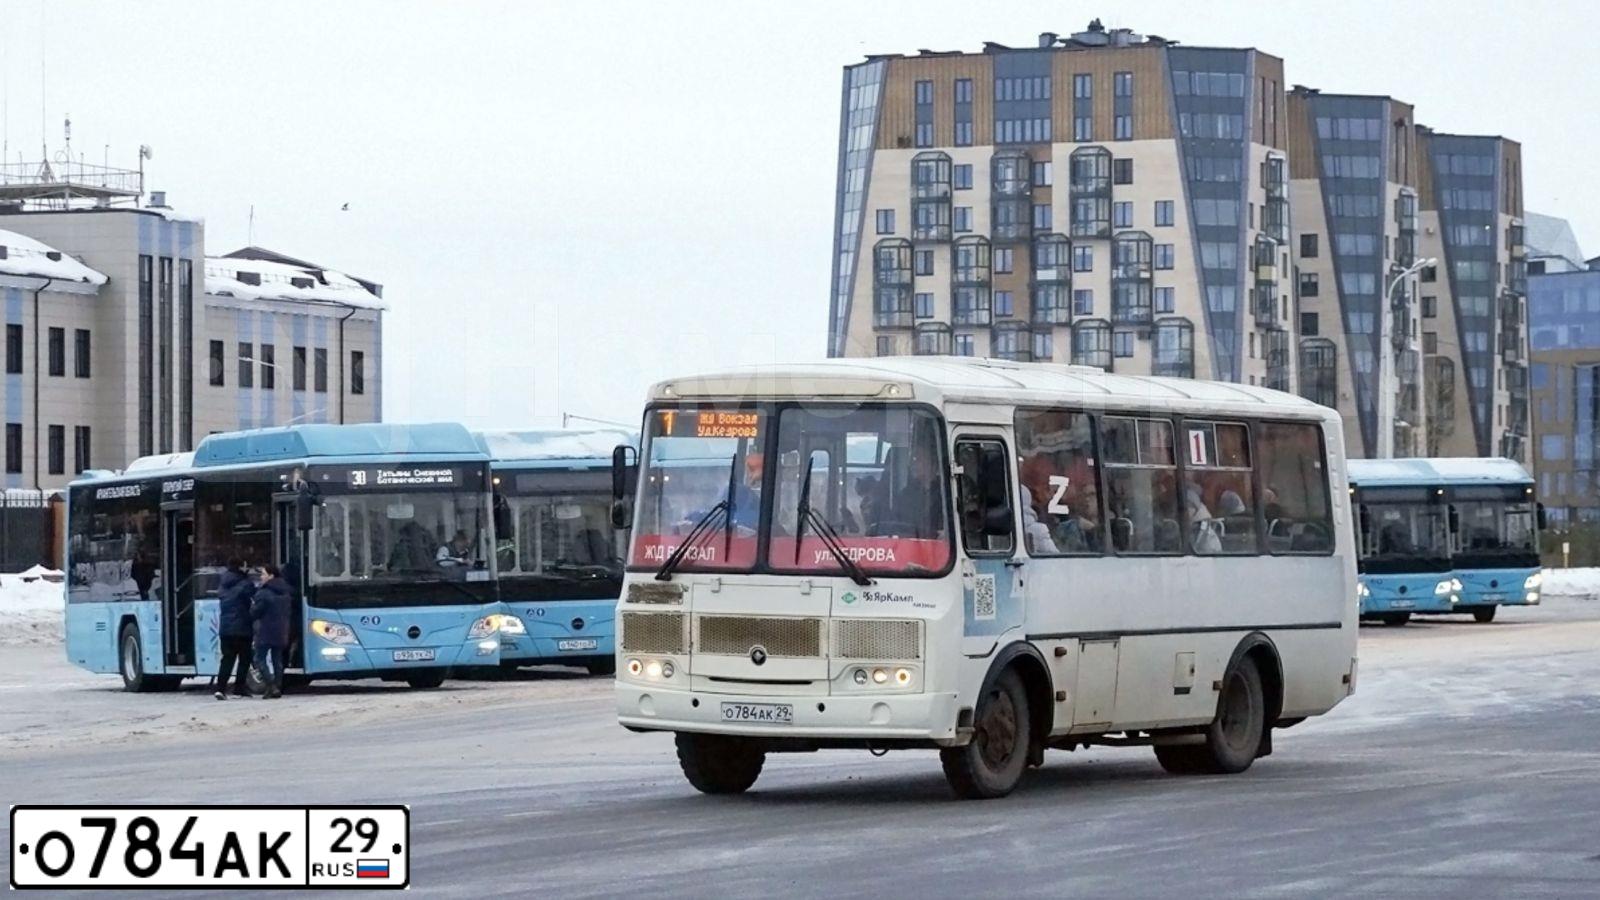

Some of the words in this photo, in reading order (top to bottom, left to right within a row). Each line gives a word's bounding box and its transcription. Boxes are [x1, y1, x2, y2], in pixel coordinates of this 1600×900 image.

[663, 412, 672, 435] 1
[719, 413, 758, 424] Вокзал
[1193, 432, 1203, 463] 1
[352, 470, 366, 485] 30
[1047, 475, 1070, 515] Z
[667, 545, 715, 561] ВКЗАЛ
[725, 705, 773, 720] О784АК
[776, 706, 789, 718] 29
